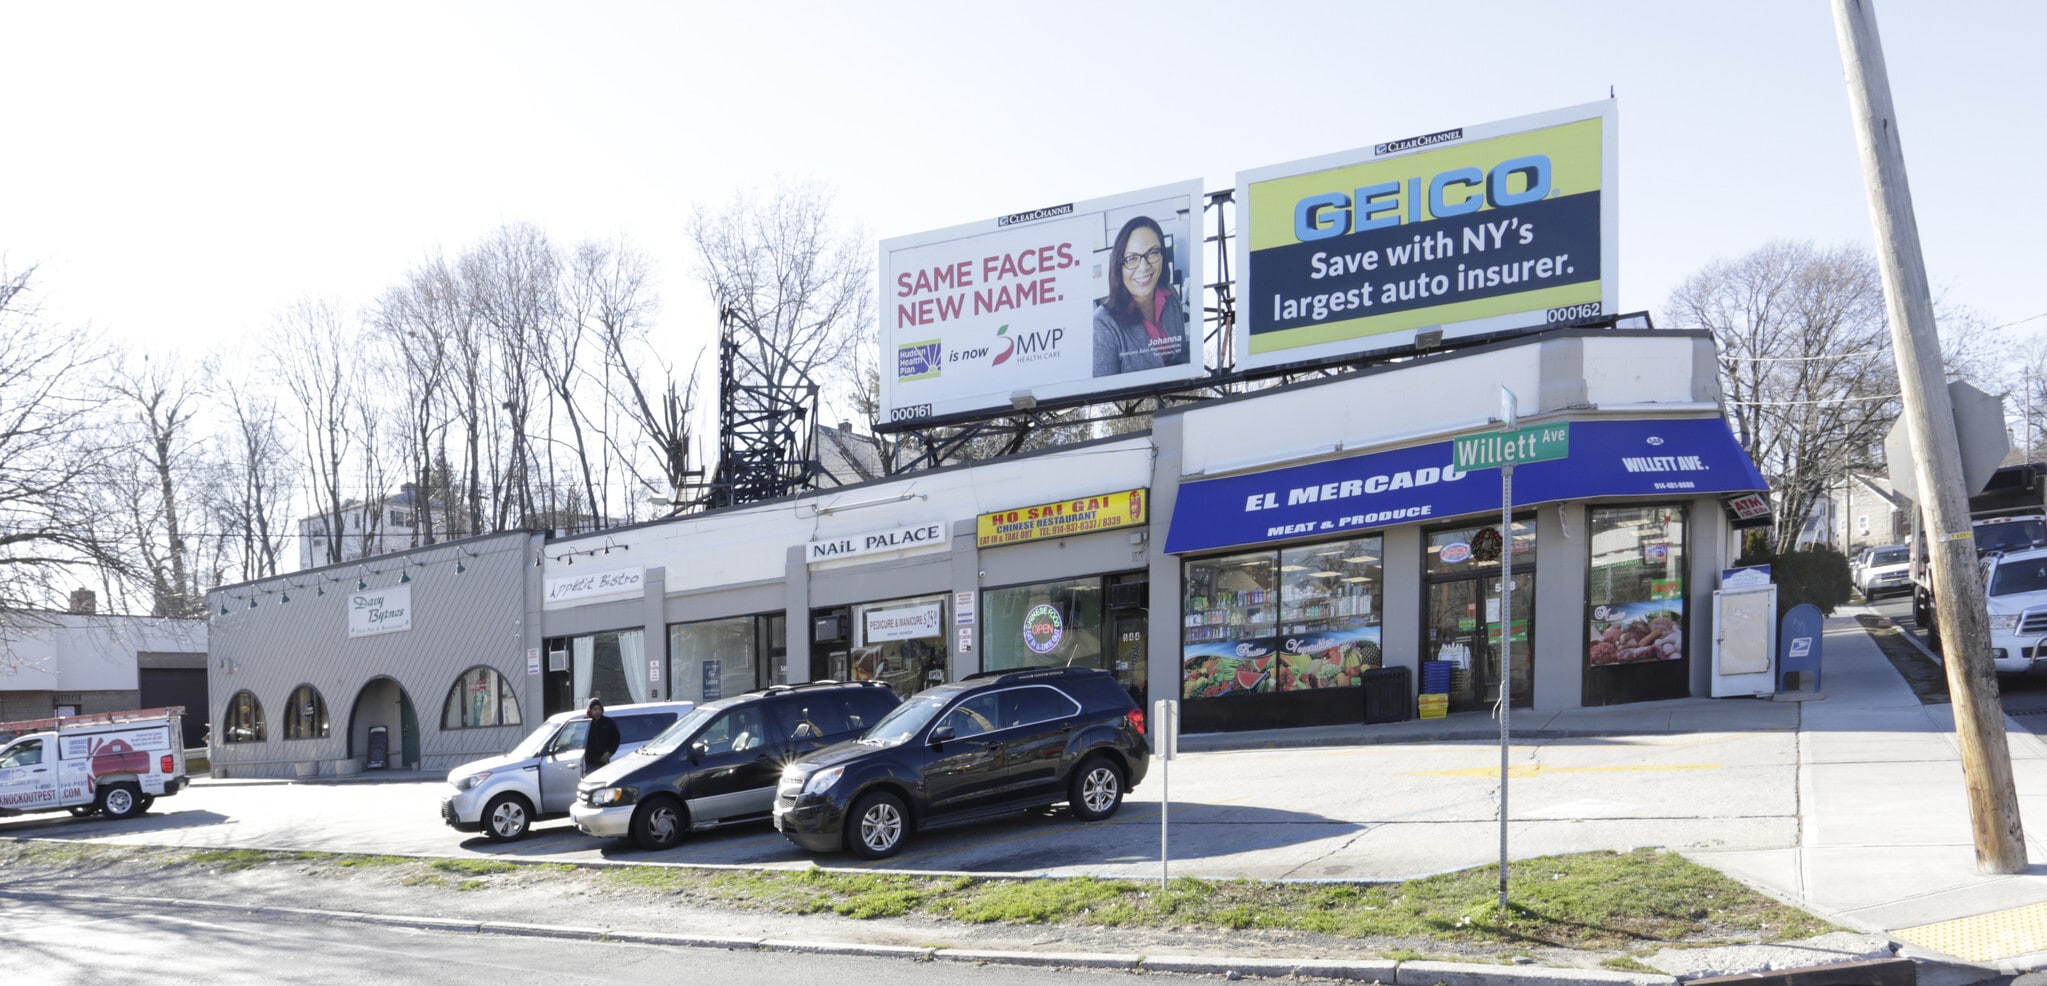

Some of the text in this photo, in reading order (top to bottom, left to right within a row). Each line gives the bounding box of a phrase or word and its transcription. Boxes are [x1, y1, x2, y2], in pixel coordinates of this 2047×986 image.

[1294, 154, 1552, 243] GEICO
[1310, 217, 1534, 280] Save with NY's
[897, 242, 1081, 298] SAME FACES.
[1273, 253, 1575, 322] largest auto insurer.
[898, 277, 1064, 329] NEW NAME.
[1548, 302, 1601, 323] 000162
[1017, 327, 1063, 352] MVP
[1148, 334, 1182, 347] Johanna
[900, 348, 926, 359] Hudson
[900, 357, 923, 367] Health
[948, 345, 990, 364] is now
[1017, 350, 1061, 365] HEALTH CARE
[900, 366, 916, 375] Plan
[892, 404, 932, 423] 000161
[1458, 428, 1565, 467] Willett Ave
[1622, 456, 1678, 473] WILLETT
[992, 496, 1109, 526] HO SAI GAI
[1245, 493, 1279, 512] EL
[1734, 498, 1764, 512] ATM
[996, 510, 1097, 534] CHINESE RESTAURANT
[1267, 505, 1432, 537] MEAT & PRODUCE
[866, 525, 940, 550] PALACE
[980, 536, 990, 546] EAT
[990, 535, 998, 544] IN
[1005, 532, 1019, 542] TAKE
[1020, 530, 1032, 540] OUT
[599, 573, 639, 588] Bistro
[1495, 581, 1516, 593] 58
[353, 596, 385, 609] Davy
[368, 608, 405, 623] Byrnes
[869, 619, 894, 631] PEDICURE
[899, 615, 923, 627] MANICURE
[1048, 608, 1060, 627] FOOD
[1032, 623, 1054, 635] OPEN
